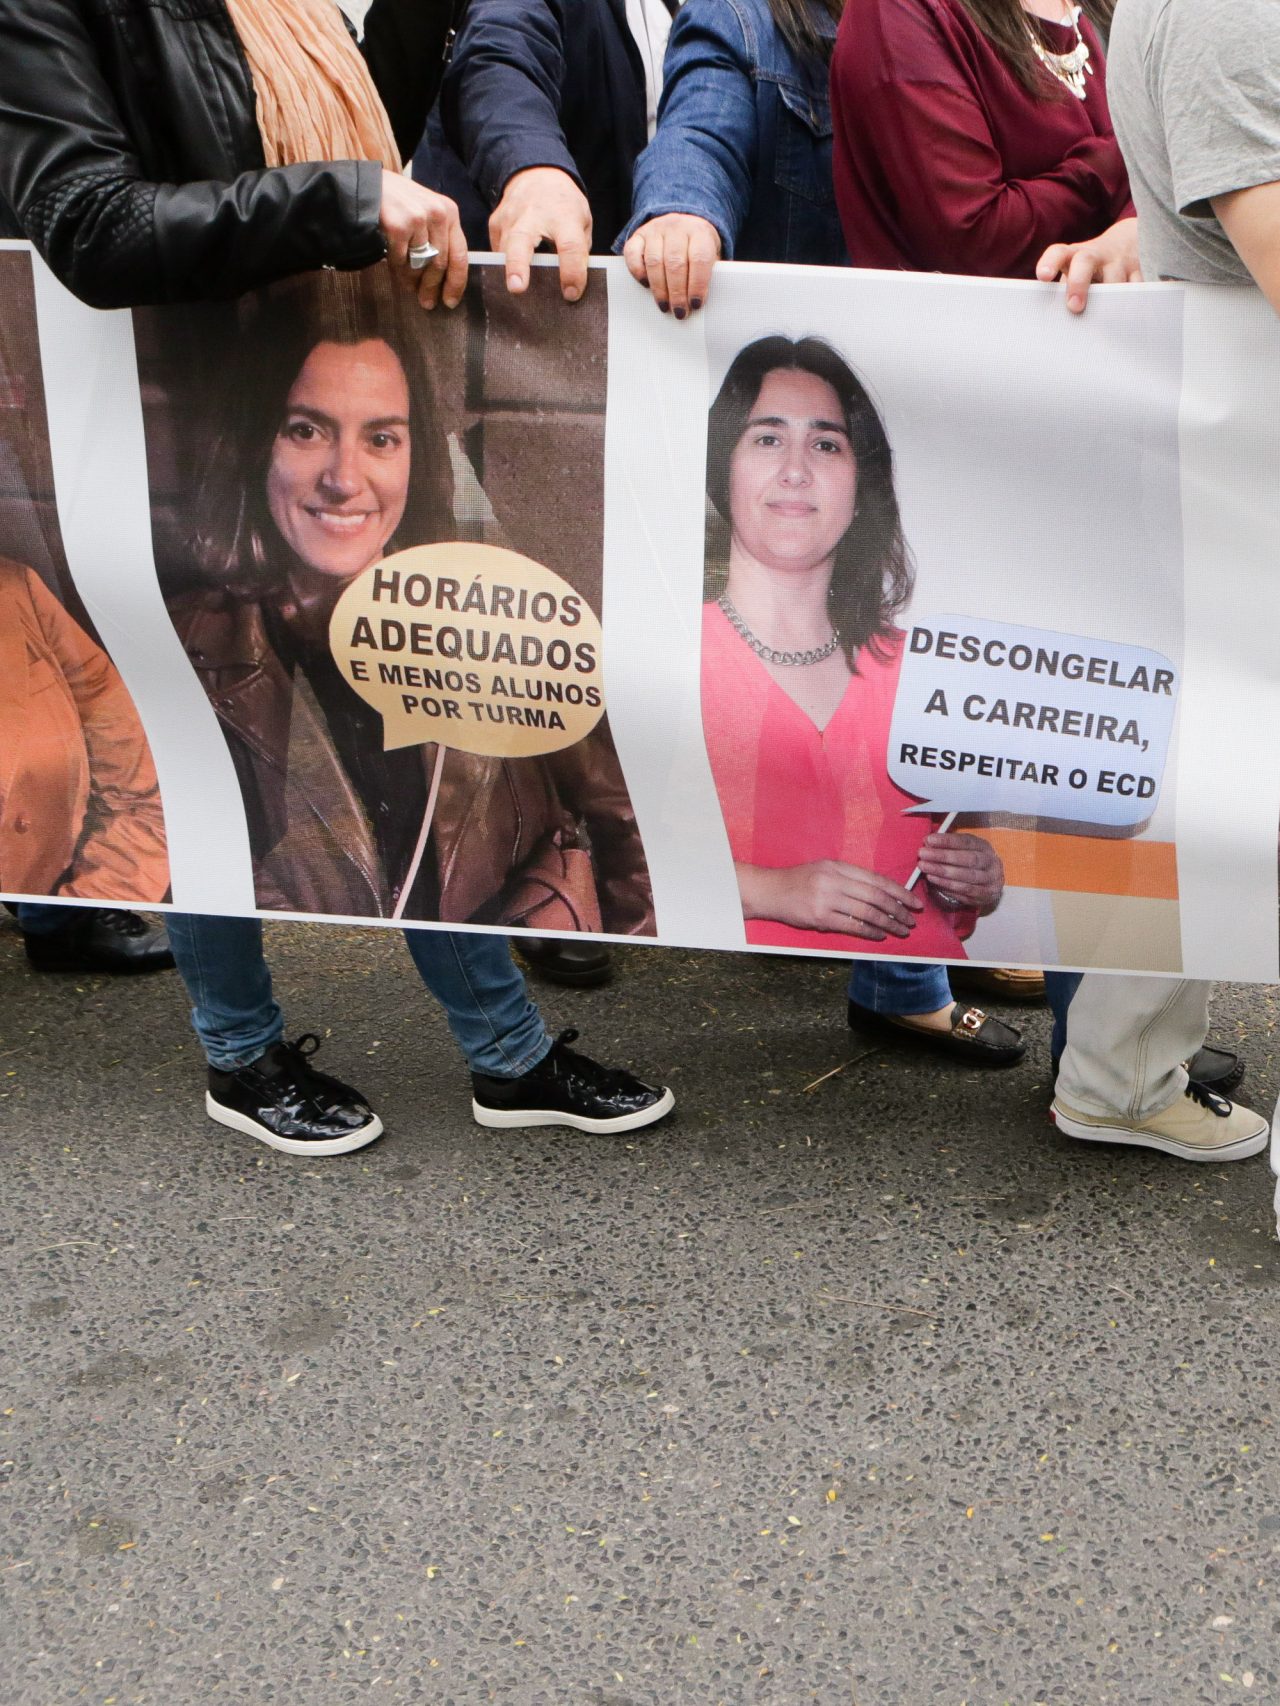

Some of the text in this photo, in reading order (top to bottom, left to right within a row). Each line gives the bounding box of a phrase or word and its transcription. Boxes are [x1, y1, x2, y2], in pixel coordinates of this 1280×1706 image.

[372, 568, 582, 628] HORÁRIOS
[350, 616, 597, 674] ADEQUADOS
[909, 626, 1174, 696] DESCONGELAR
[350, 660, 602, 708] E MENOS ALUNOS
[402, 694, 566, 731] POR TURMA
[924, 688, 1150, 752] A CARREIRA,
[899, 743, 1156, 799] RESPEITAR O ECD
